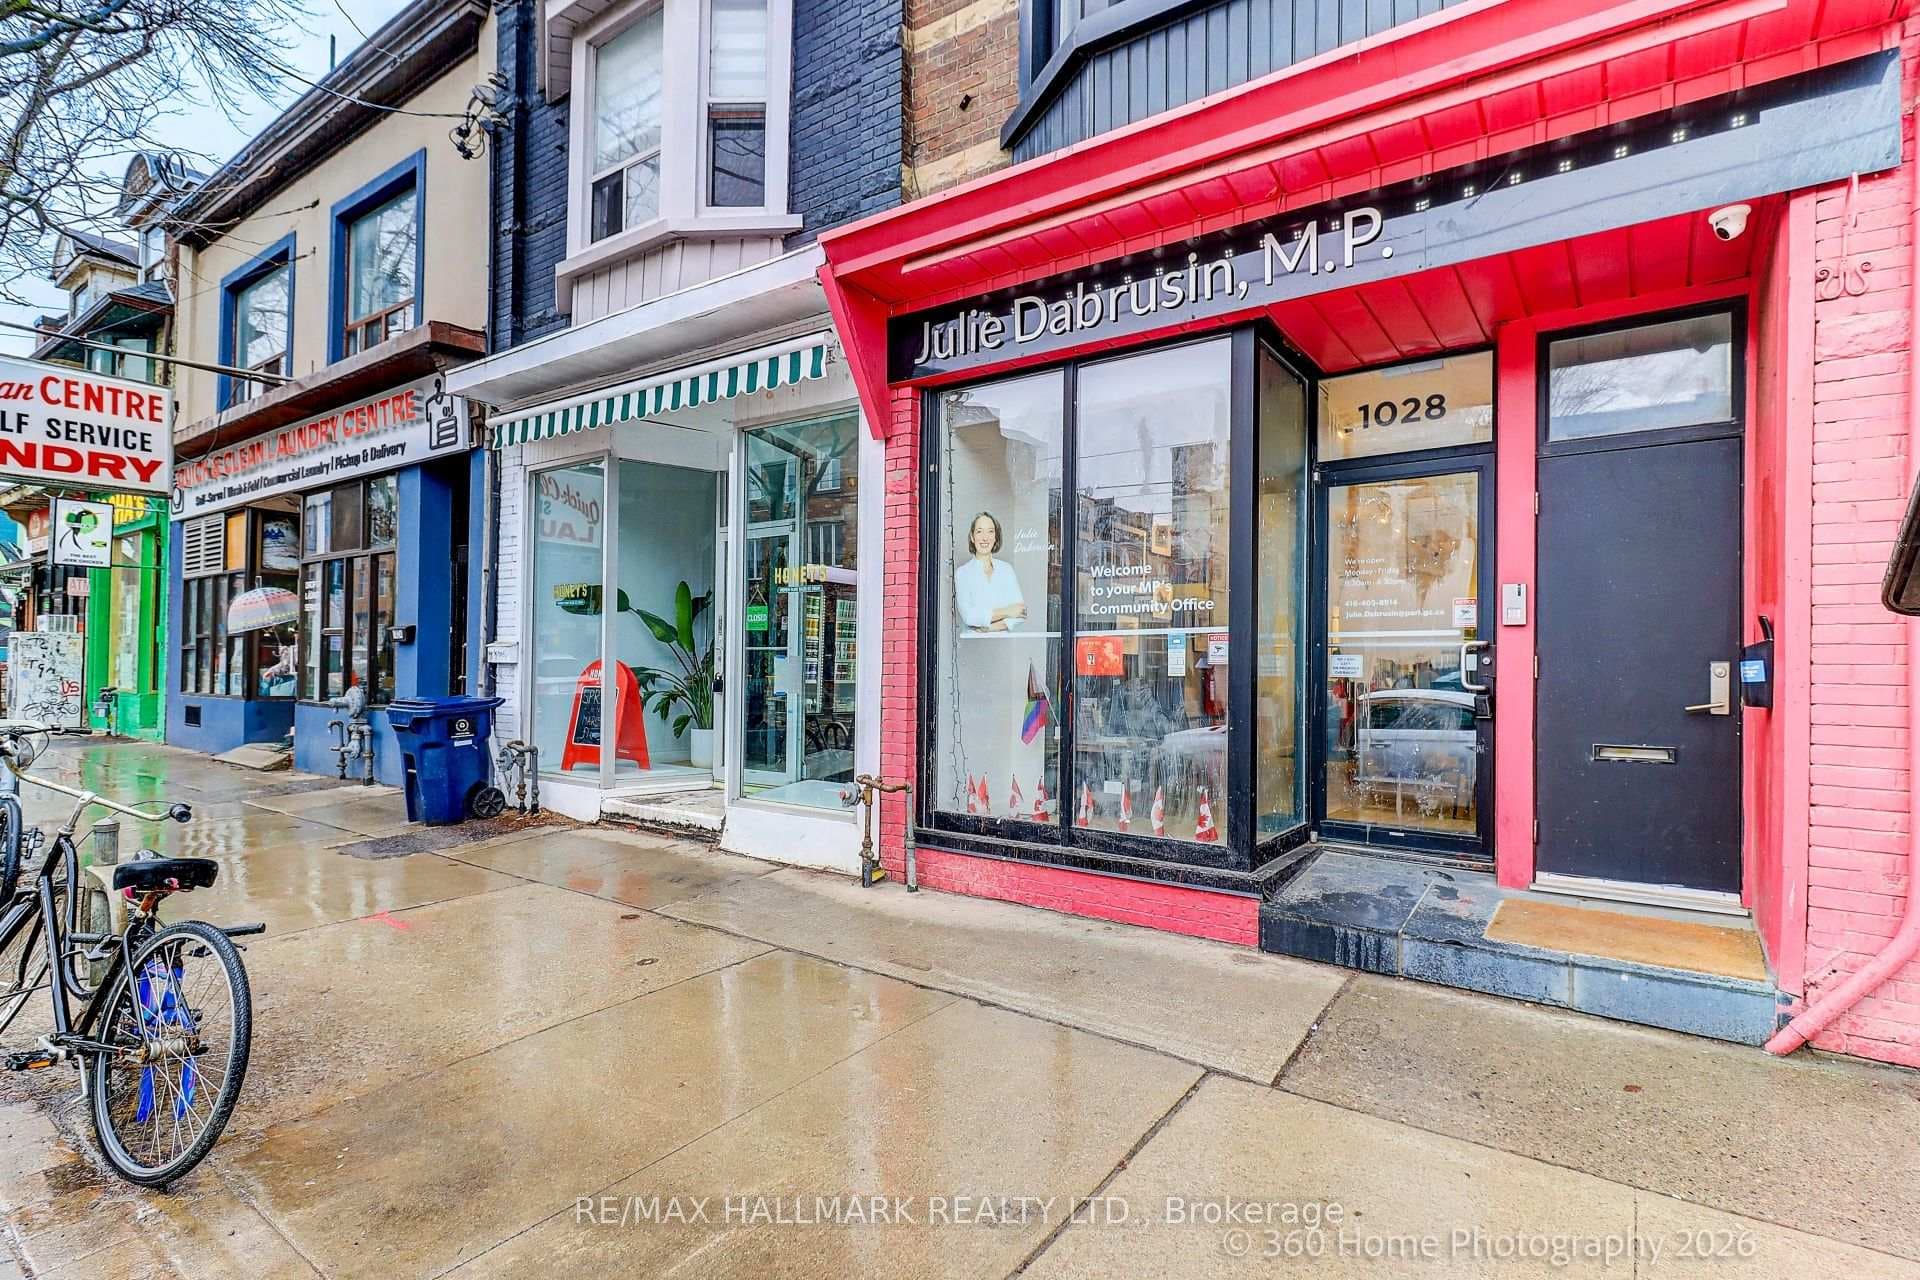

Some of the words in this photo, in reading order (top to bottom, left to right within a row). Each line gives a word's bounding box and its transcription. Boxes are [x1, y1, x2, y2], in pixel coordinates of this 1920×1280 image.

[914, 309, 1004, 366] Julie
[1014, 252, 1249, 345] Dabrusin,
[1263, 206, 1394, 285] M.P.
[40, 375, 164, 423] CENTRE
[1358, 394, 1446, 429] 1028
[46, 417, 153, 453] SERVICE
[175, 459, 209, 489] QUICK
[223, 440, 264, 474] CLEAN
[266, 416, 339, 459] LAUNDRY
[342, 389, 418, 438] CENTRE
[0, 438, 164, 483] NDRY
[263, 467, 300, 488] Commercial
[301, 460, 330, 479] Laundry
[335, 453, 361, 471] Pickup
[362, 448, 369, 463] &
[370, 441, 407, 462] Delivery
[775, 564, 828, 585] HONEY'S
[1090, 564, 1152, 577] Welcome
[554, 583, 588, 598] HONEY'S
[1090, 584, 1104, 597] to
[1106, 584, 1137, 599] your
[1138, 580, 1173, 594] MP's
[1090, 599, 1168, 616] Community
[1171, 598, 1215, 611] Office
[747, 613, 768, 622] CLOSED
